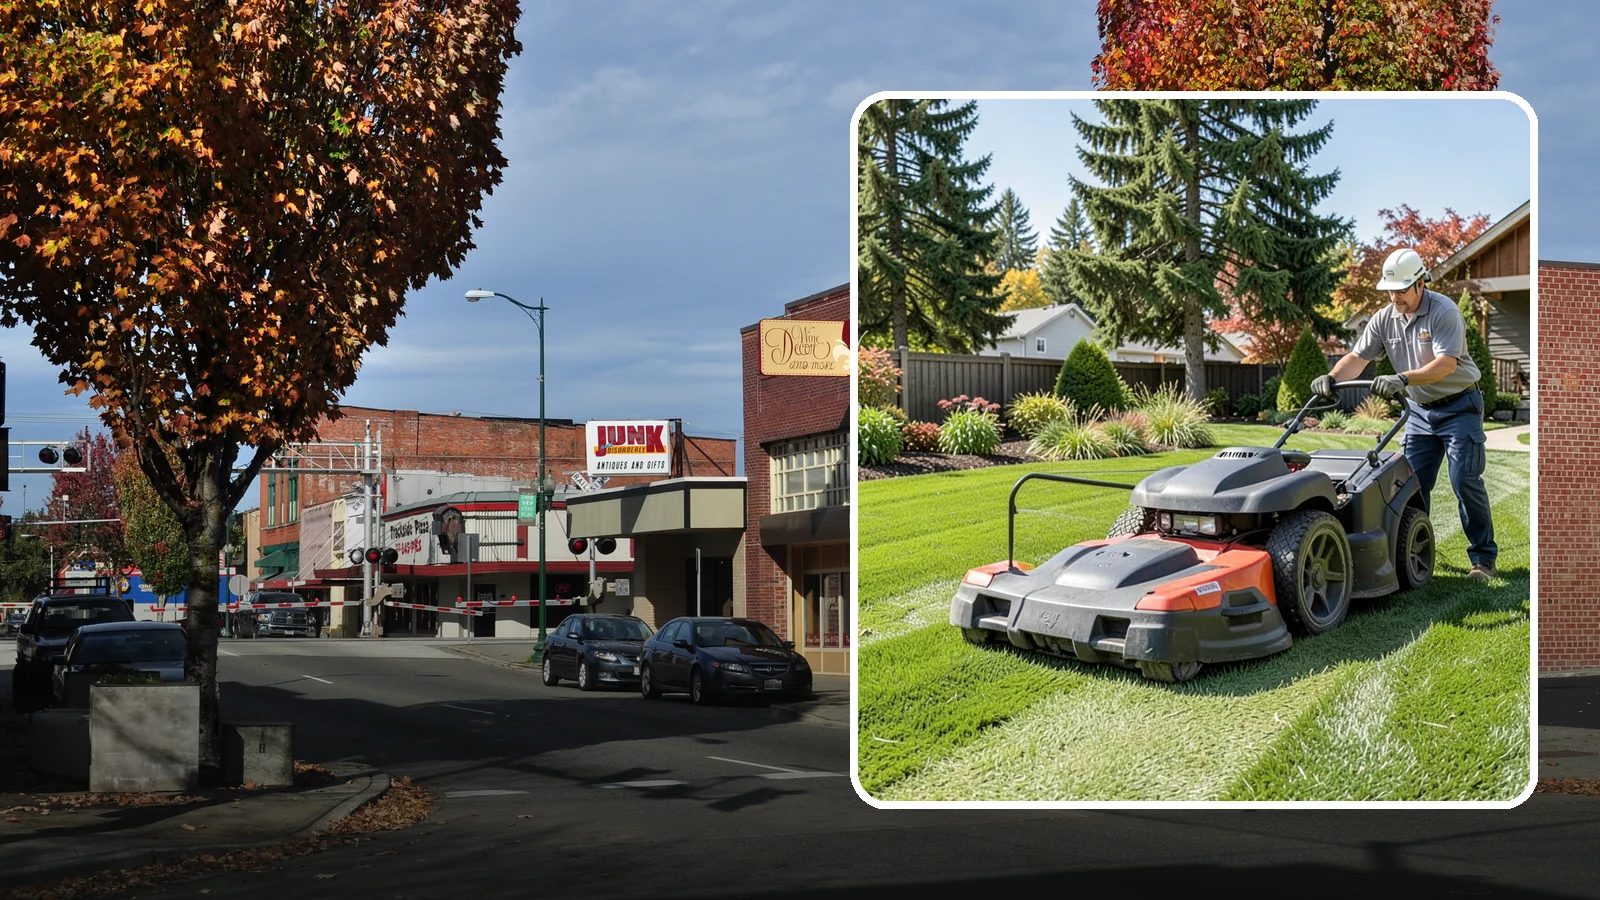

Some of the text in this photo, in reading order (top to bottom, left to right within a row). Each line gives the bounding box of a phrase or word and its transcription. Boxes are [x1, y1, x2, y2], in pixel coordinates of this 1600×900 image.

[596, 425, 665, 457] JUNK
[607, 446, 646, 454] DISORDERLY
[597, 460, 665, 470] ANTIQUES AND GIFTS
[352, 498, 364, 511] CRO
[390, 519, 429, 540] Trackside Pizza
